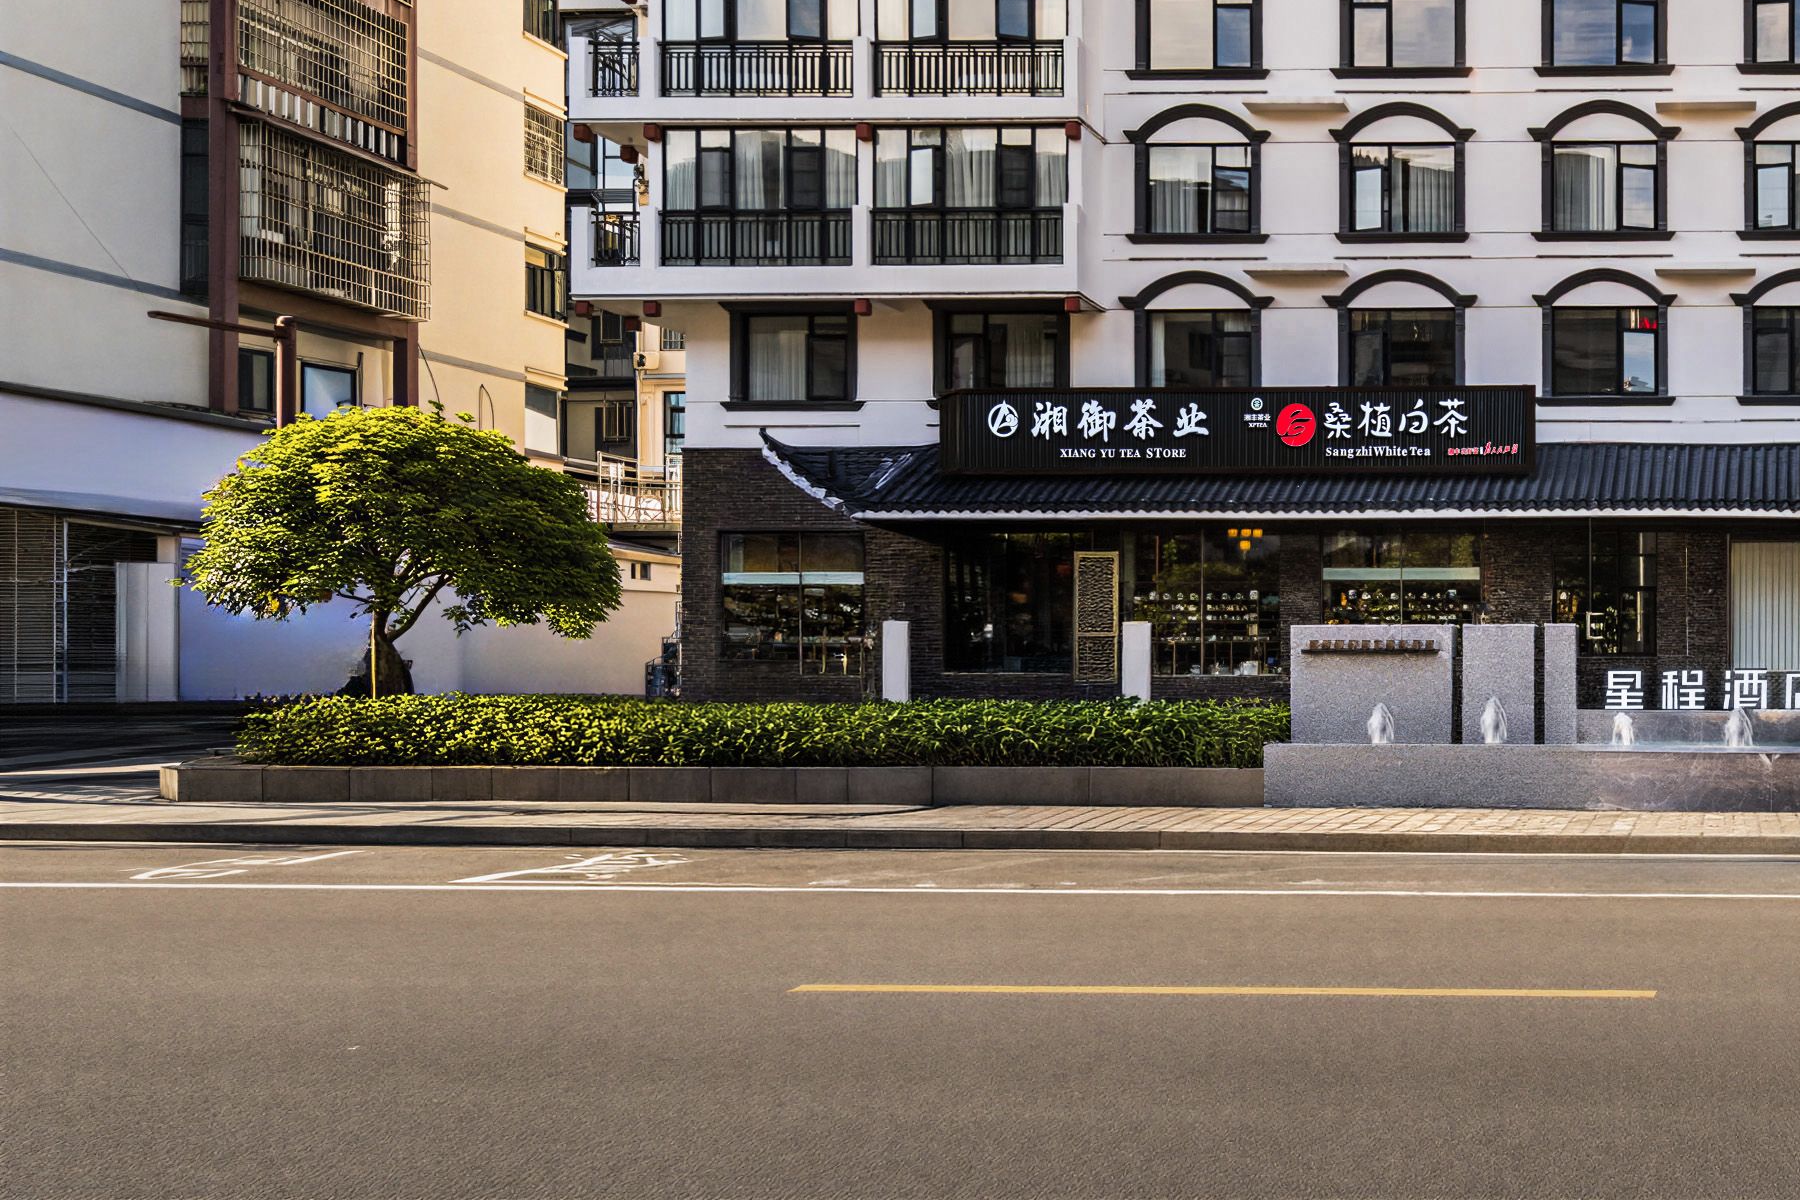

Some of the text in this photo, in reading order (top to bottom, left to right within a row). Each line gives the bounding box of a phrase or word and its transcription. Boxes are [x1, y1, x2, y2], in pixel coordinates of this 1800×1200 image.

[1031, 398, 1210, 443] 湘御茶业
[1323, 398, 1469, 439] 桑植白茶
[1060, 447, 1187, 459] XIANG YU TEA STORE
